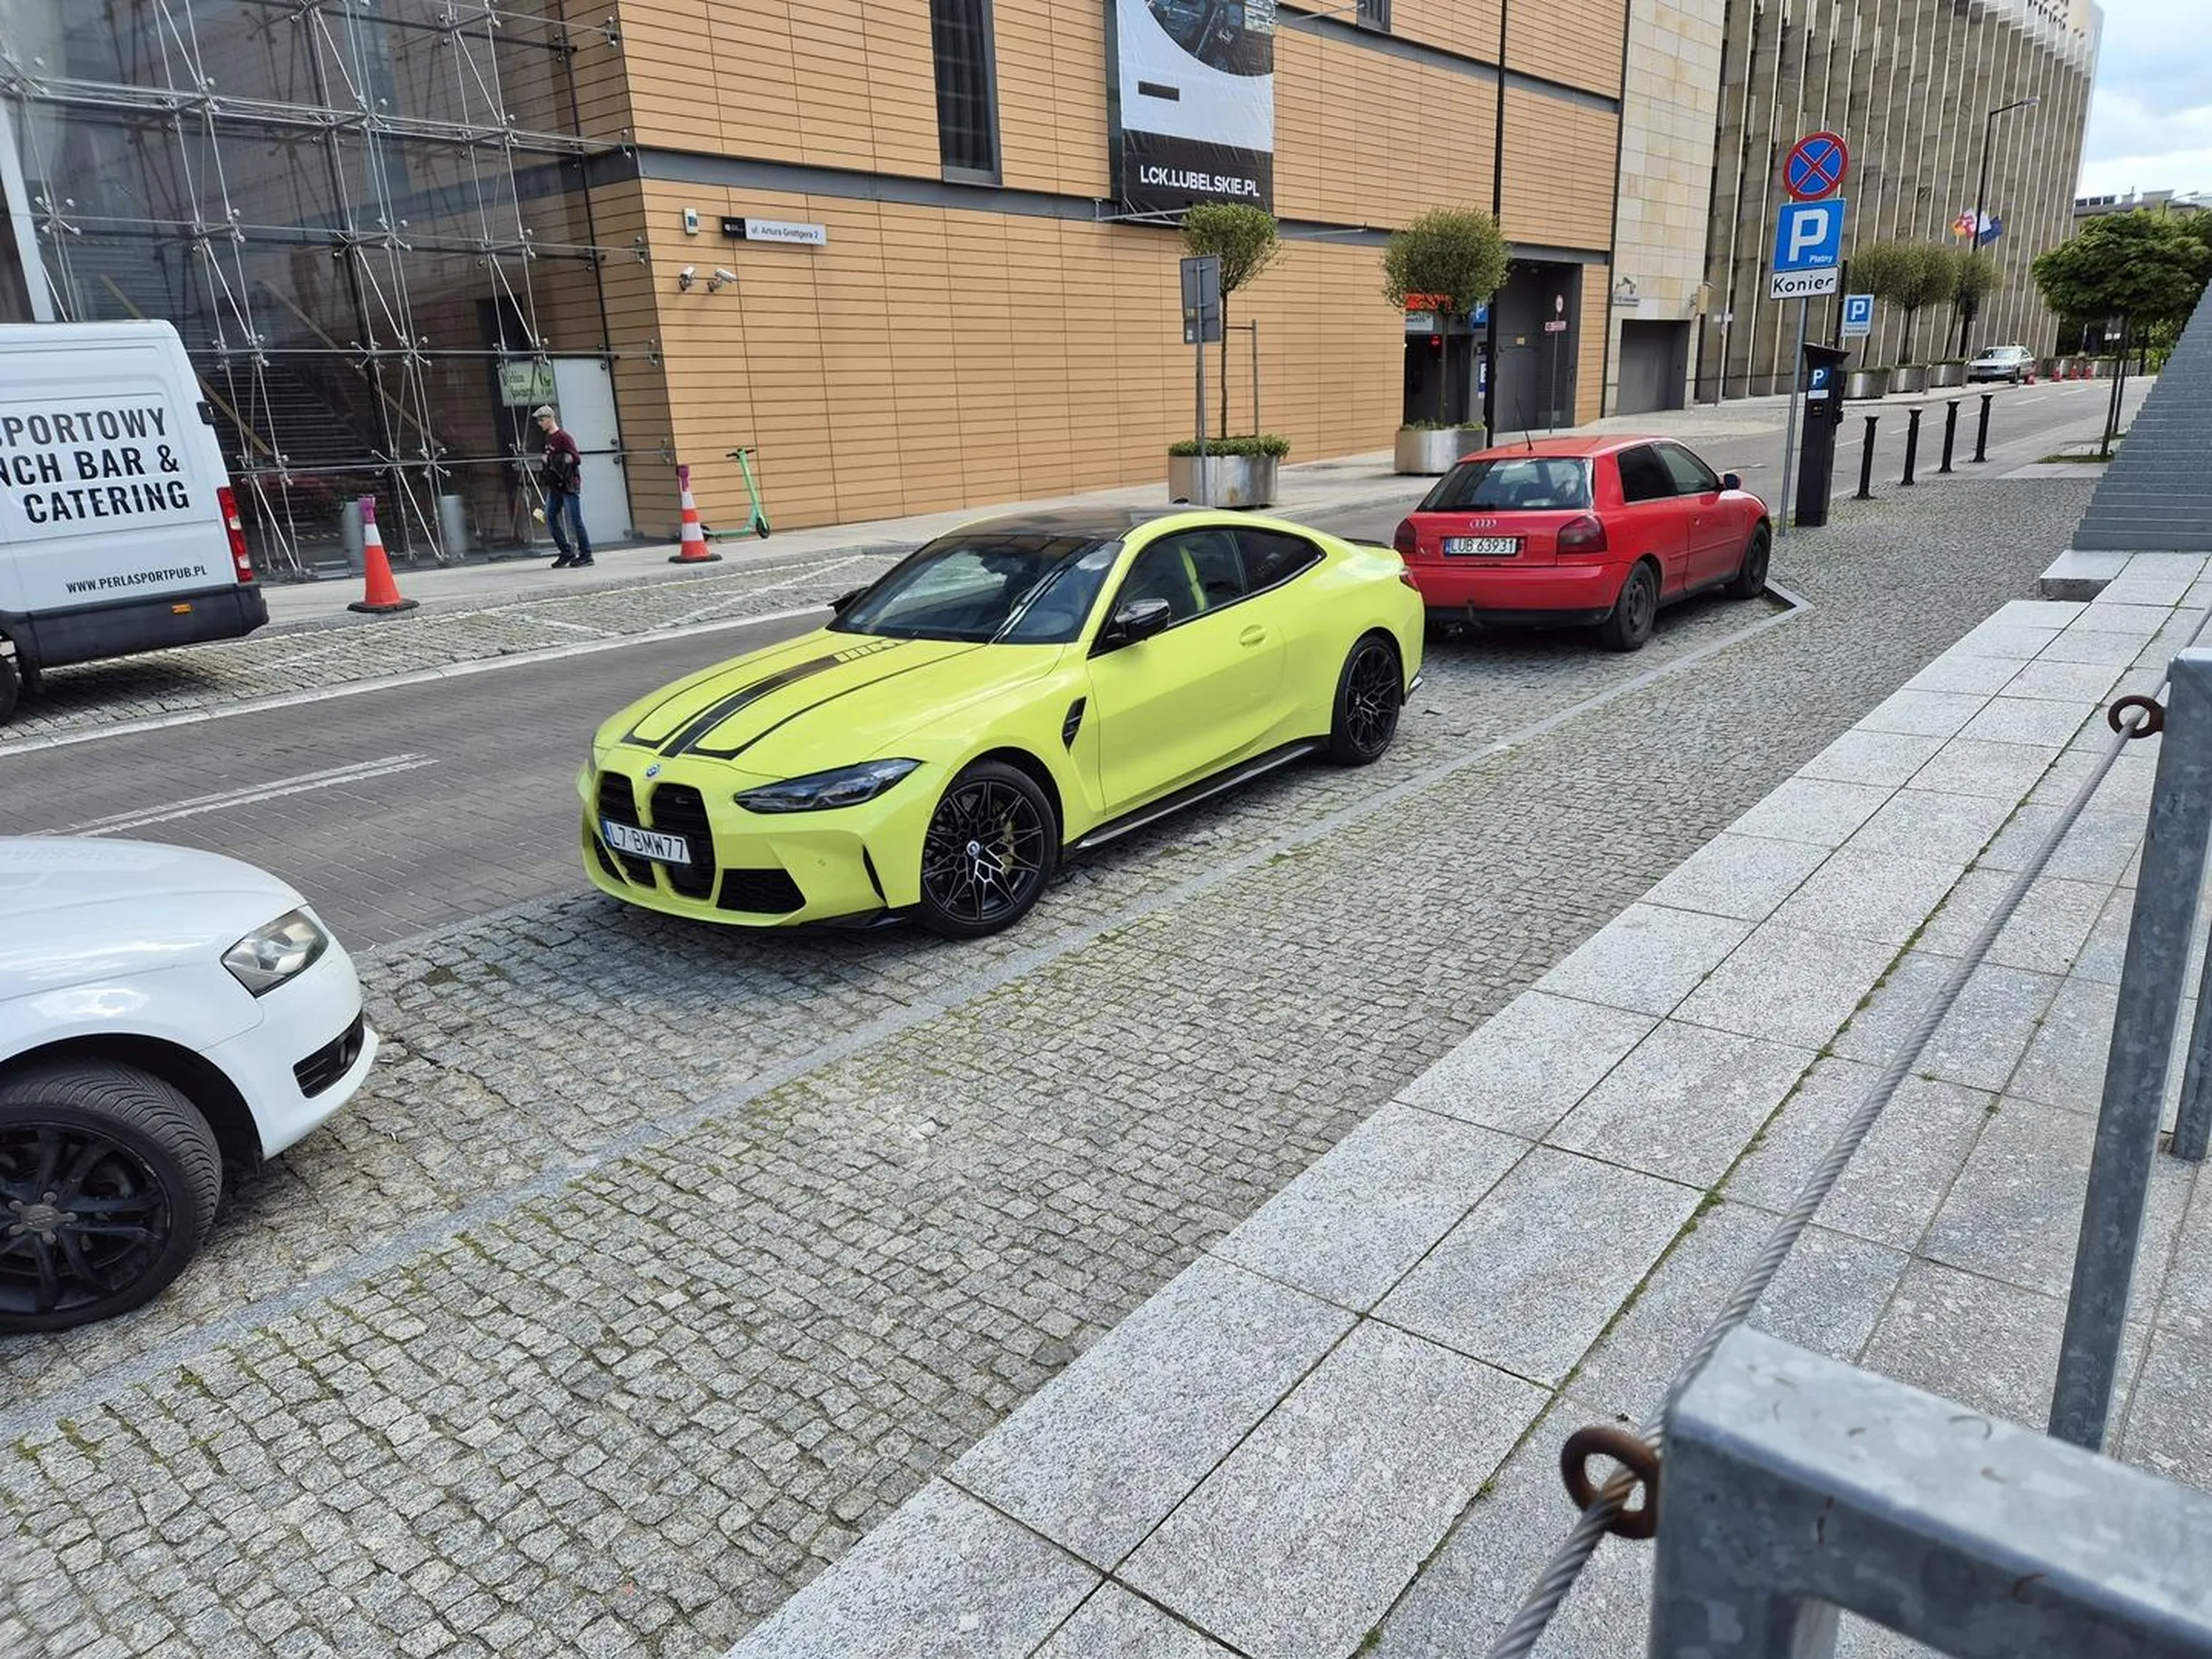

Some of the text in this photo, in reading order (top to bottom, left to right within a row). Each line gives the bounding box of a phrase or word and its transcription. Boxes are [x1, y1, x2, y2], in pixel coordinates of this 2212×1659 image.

[1141, 165, 1260, 197] LCK.LUBELSKIE.PL
[1788, 208, 1829, 262] P
[1851, 301, 1865, 320] P
[0, 408, 165, 447] PORTOWY
[73, 447, 146, 480] BAR
[157, 444, 180, 472] &
[23, 480, 189, 524] CATERING
[1452, 538, 1513, 552] LUB 63931
[66, 565, 208, 594] WWW.PERLASPORTPUB.PL
[609, 825, 684, 860] L7 BMW77
